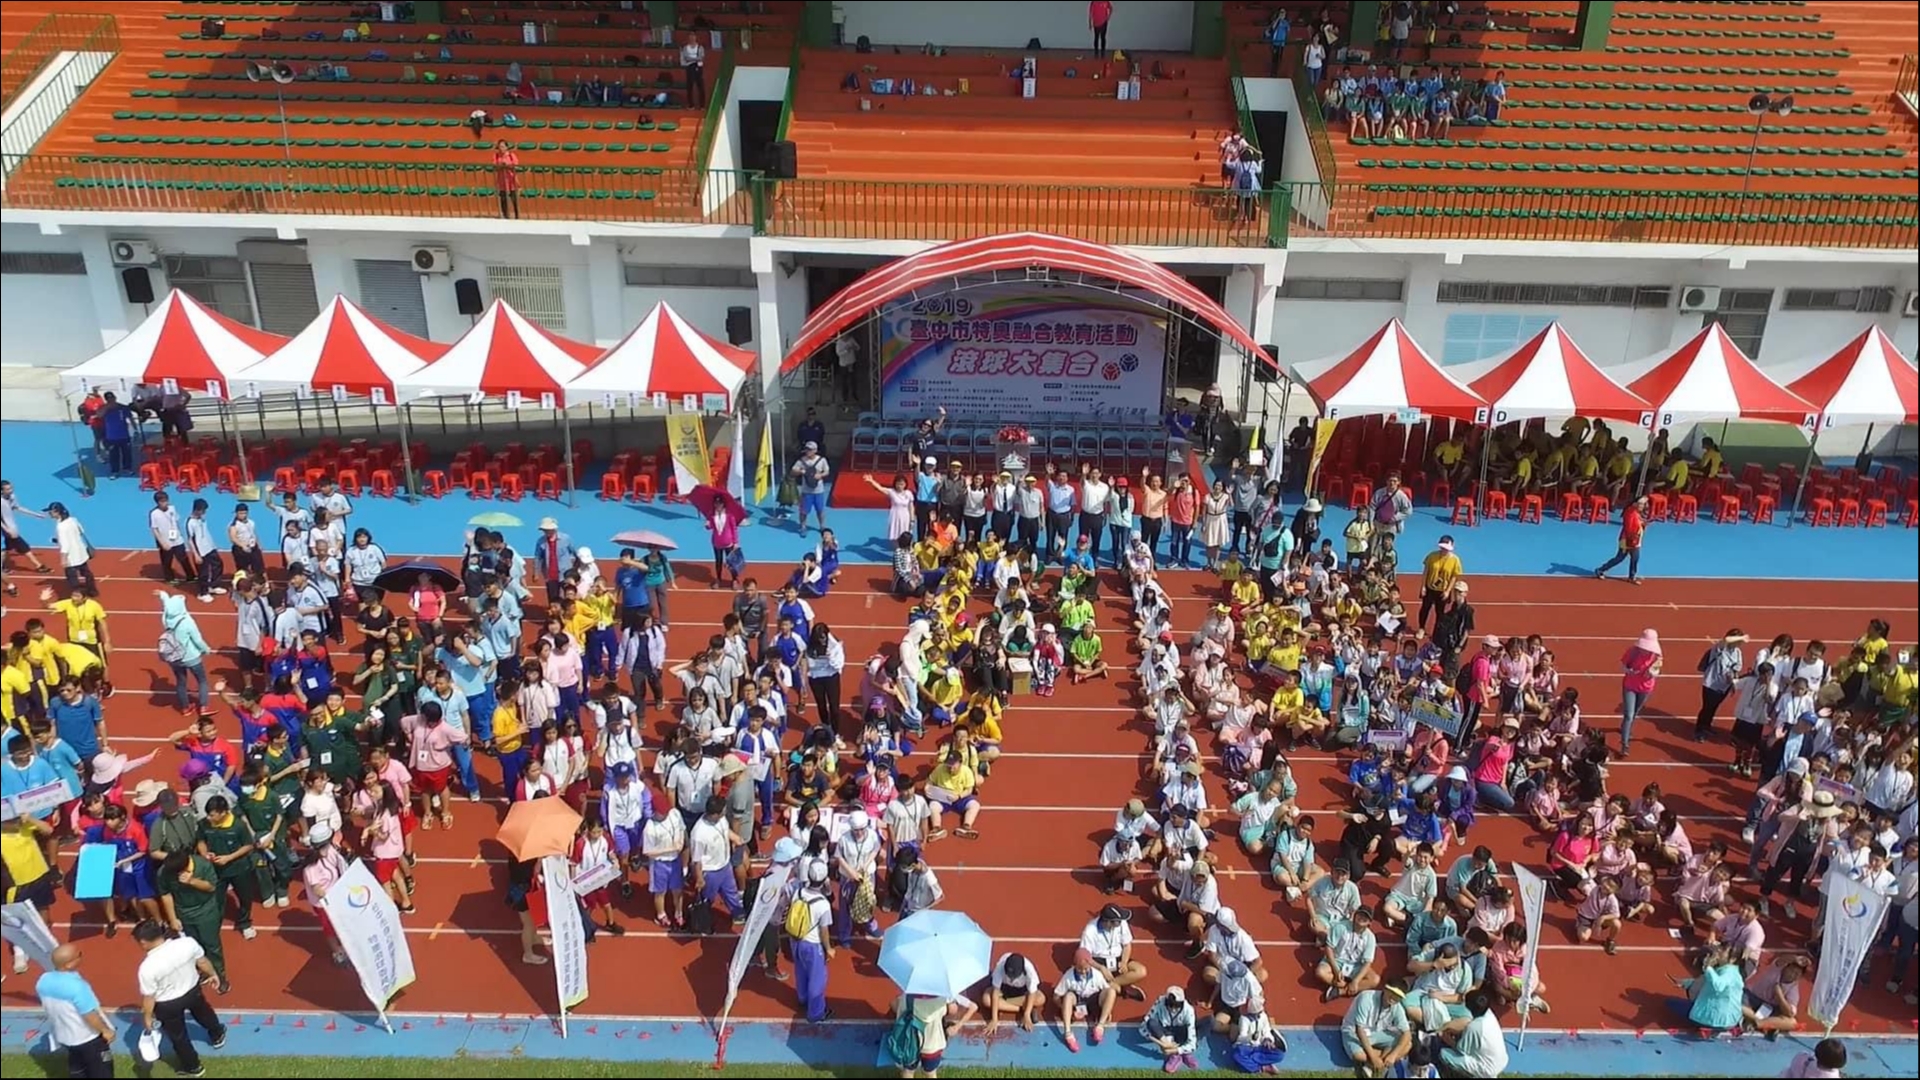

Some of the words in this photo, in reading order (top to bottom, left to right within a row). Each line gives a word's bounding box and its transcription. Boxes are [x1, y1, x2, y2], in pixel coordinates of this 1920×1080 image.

[911, 296, 973, 317] 2019
[909, 318, 1138, 346] 臺中市特奧融合教育活動
[947, 349, 1098, 378] 滾球大集合
[1331, 408, 1338, 420] F
[1478, 410, 1486, 422] E
[1496, 411, 1507, 423] D
[1642, 414, 1652, 426] C
[1663, 414, 1672, 425] B
[1804, 415, 1815, 428] A
[1826, 415, 1833, 428] L
